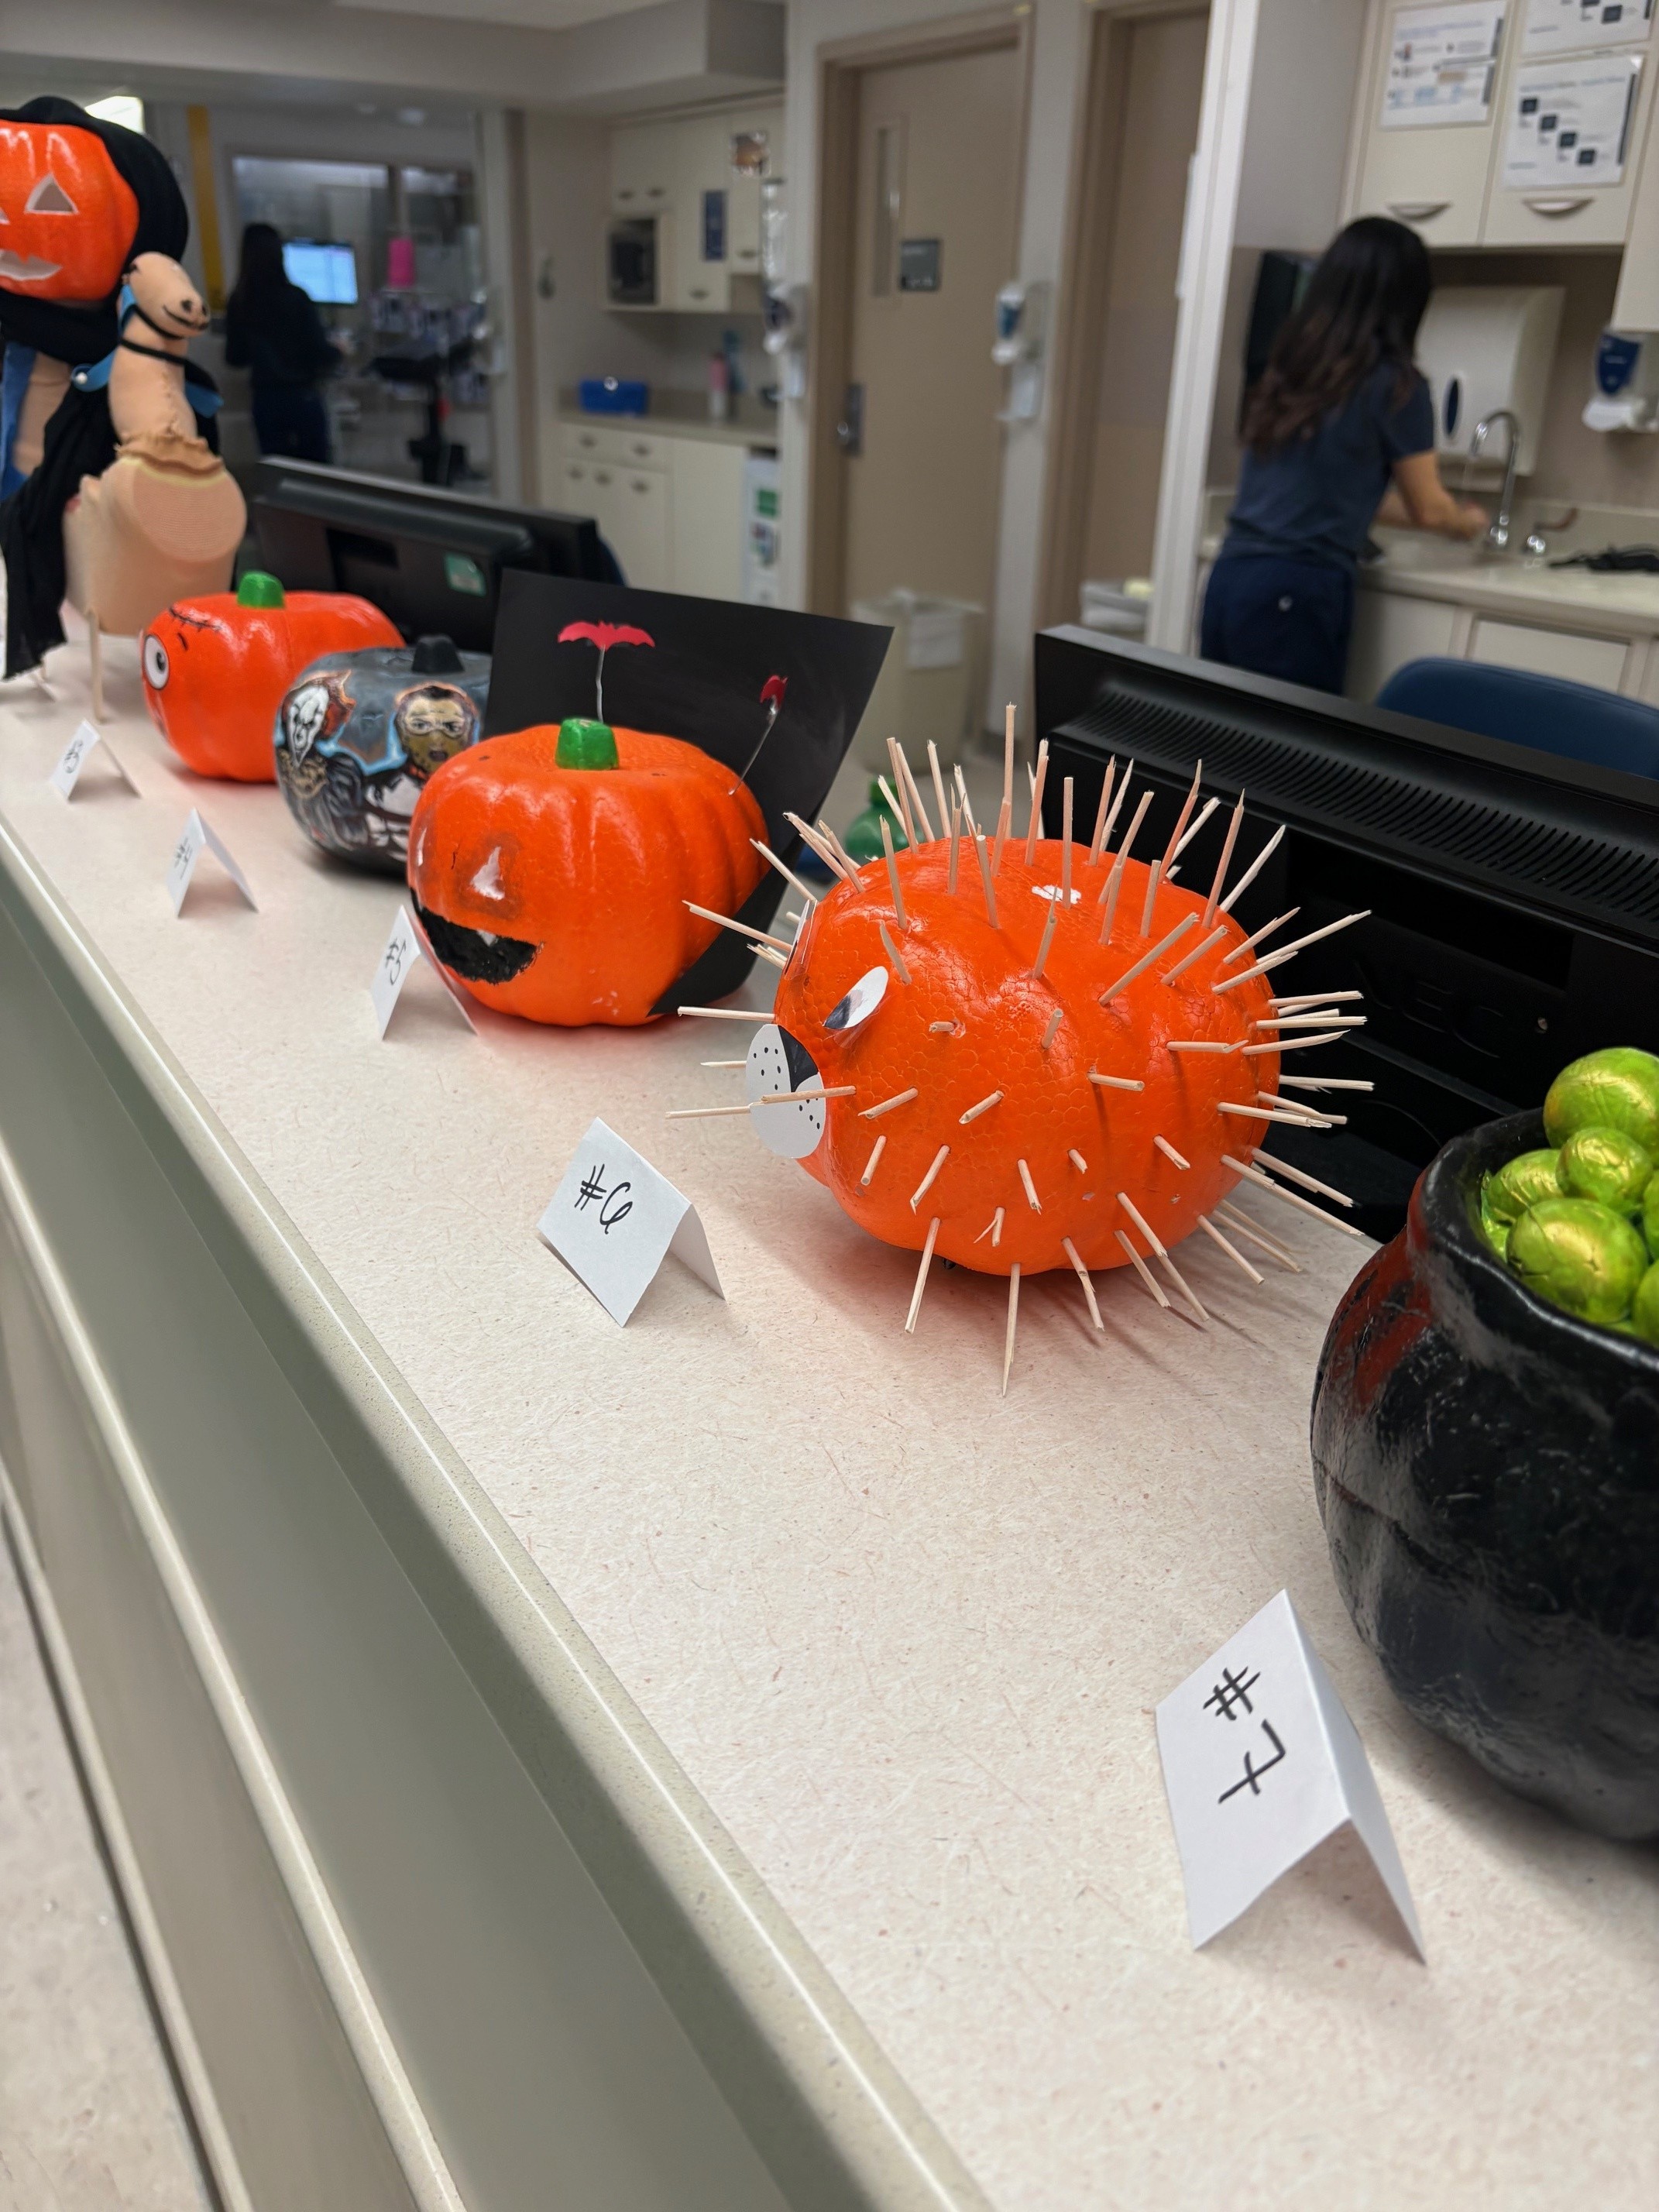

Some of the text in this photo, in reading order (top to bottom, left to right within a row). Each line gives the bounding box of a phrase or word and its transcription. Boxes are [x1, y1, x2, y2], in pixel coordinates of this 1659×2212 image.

[386, 938, 407, 986] #5
[574, 1163, 634, 1235] #6
[1202, 1665, 1286, 1805] #7
